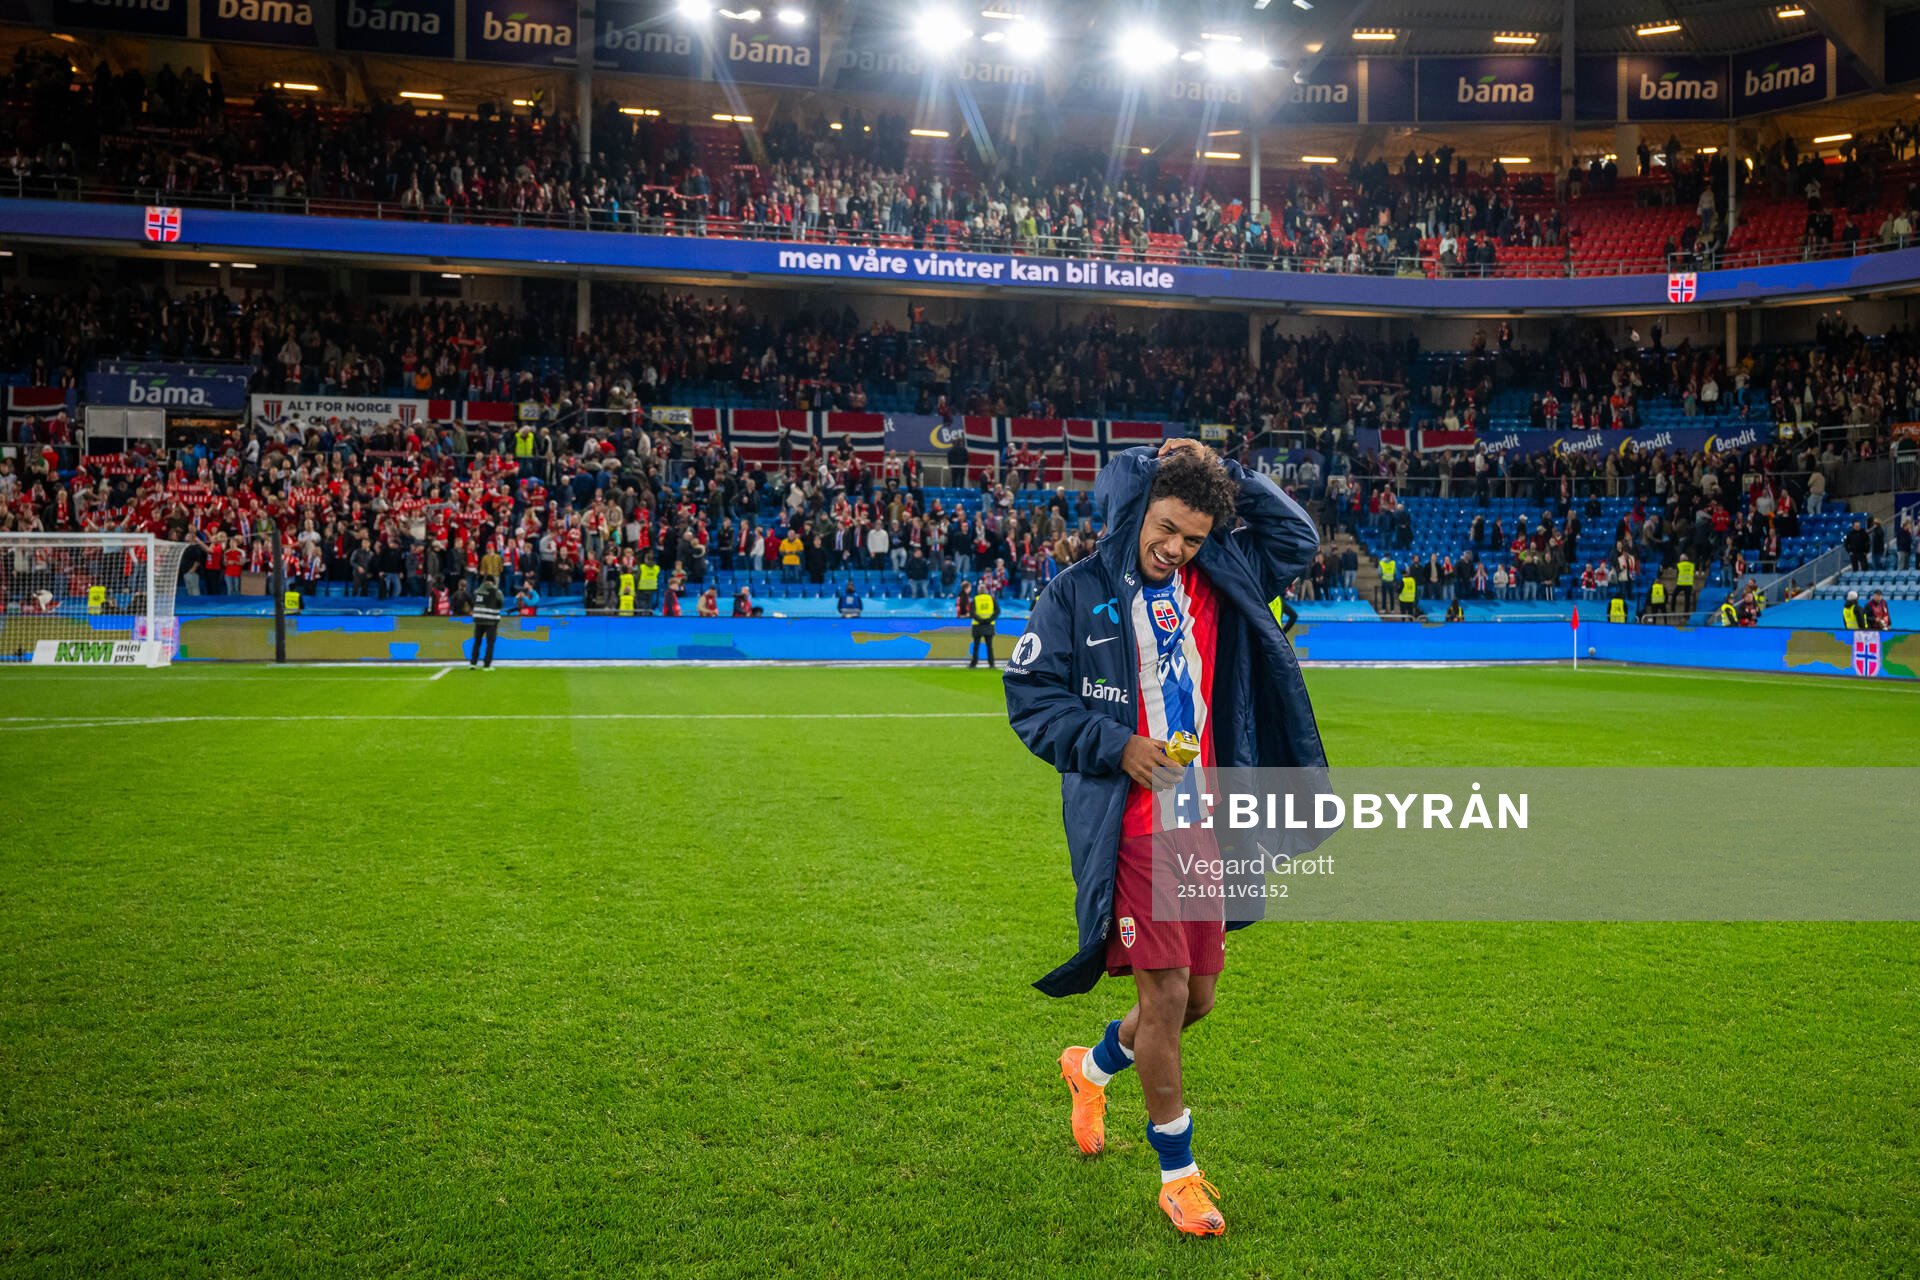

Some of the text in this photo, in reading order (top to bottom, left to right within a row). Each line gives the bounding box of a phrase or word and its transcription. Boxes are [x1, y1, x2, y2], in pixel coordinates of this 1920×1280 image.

[483, 11, 572, 46] bama
[729, 33, 811, 66] bama
[1458, 77, 1534, 102] bama
[1640, 74, 1718, 100] bama
[1745, 63, 1814, 96] bama
[779, 248, 1174, 288] men våre vintrer kan bli kalde
[129, 379, 206, 405] bama
[288, 401, 392, 413] ALT FOR NORGE
[1562, 433, 1603, 455] Bendit
[1715, 428, 1757, 452] Bendit
[54, 642, 115, 663] KIWI
[113, 652, 135, 664] pris
[116, 641, 141, 653] mini
